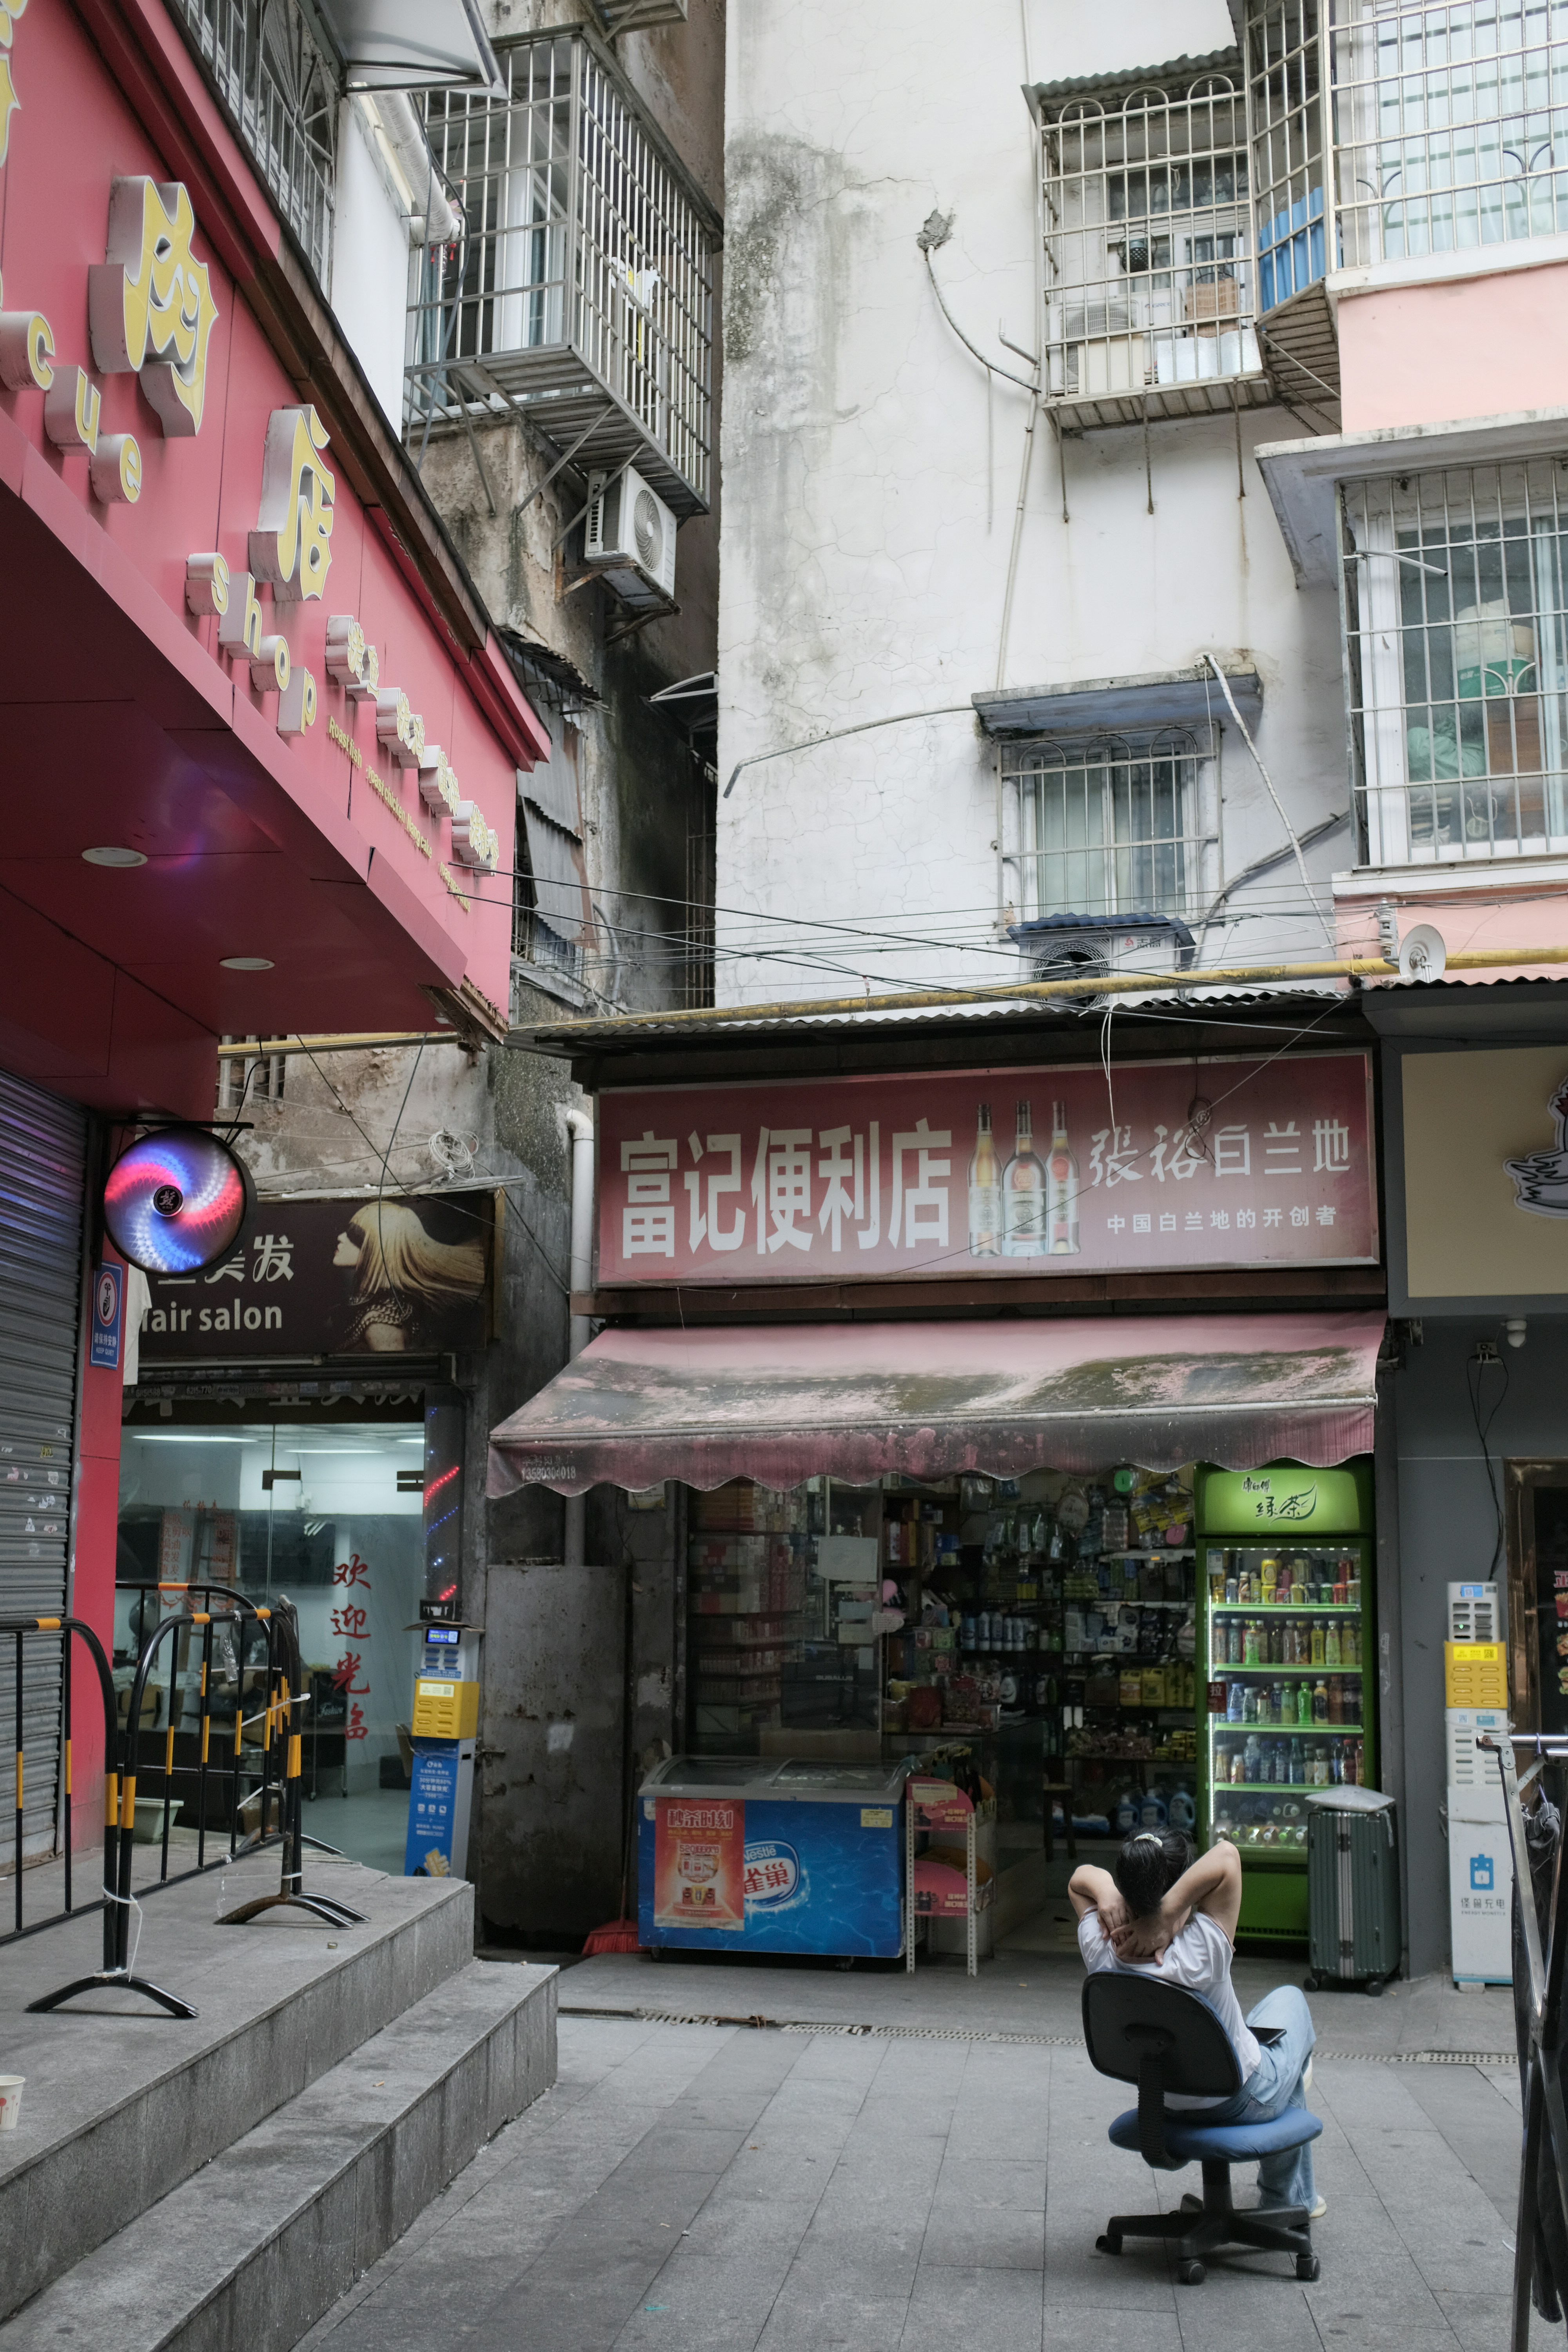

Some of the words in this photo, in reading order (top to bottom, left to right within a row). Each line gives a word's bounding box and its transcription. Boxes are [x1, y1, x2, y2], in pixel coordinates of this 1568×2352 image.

[212, 552, 317, 735] shop
[347, 616, 379, 701] 烤鱼
[328, 716, 349, 752] Roast
[349, 738, 362, 769] fish
[368, 766, 385, 797] roast
[384, 786, 405, 824] chicken
[407, 813, 421, 847] Nang
[420, 835, 432, 859] cake
[621, 1117, 952, 1259] 富记便利店
[1107, 1205, 1337, 1234] 中国白兰地的开创者
[199, 1298, 282, 1332] salon
[94, 1333, 117, 1348] 请保持安静
[105, 1348, 114, 1357] QUIET
[1256, 1495, 1300, 1518] 绿茶
[1210, 1684, 1223, 1697] 拉
[667, 1809, 734, 1829] 秒杀时刻
[744, 1862, 790, 1895] 雀巢
[1461, 1897, 1505, 1909] 怪兽充电
